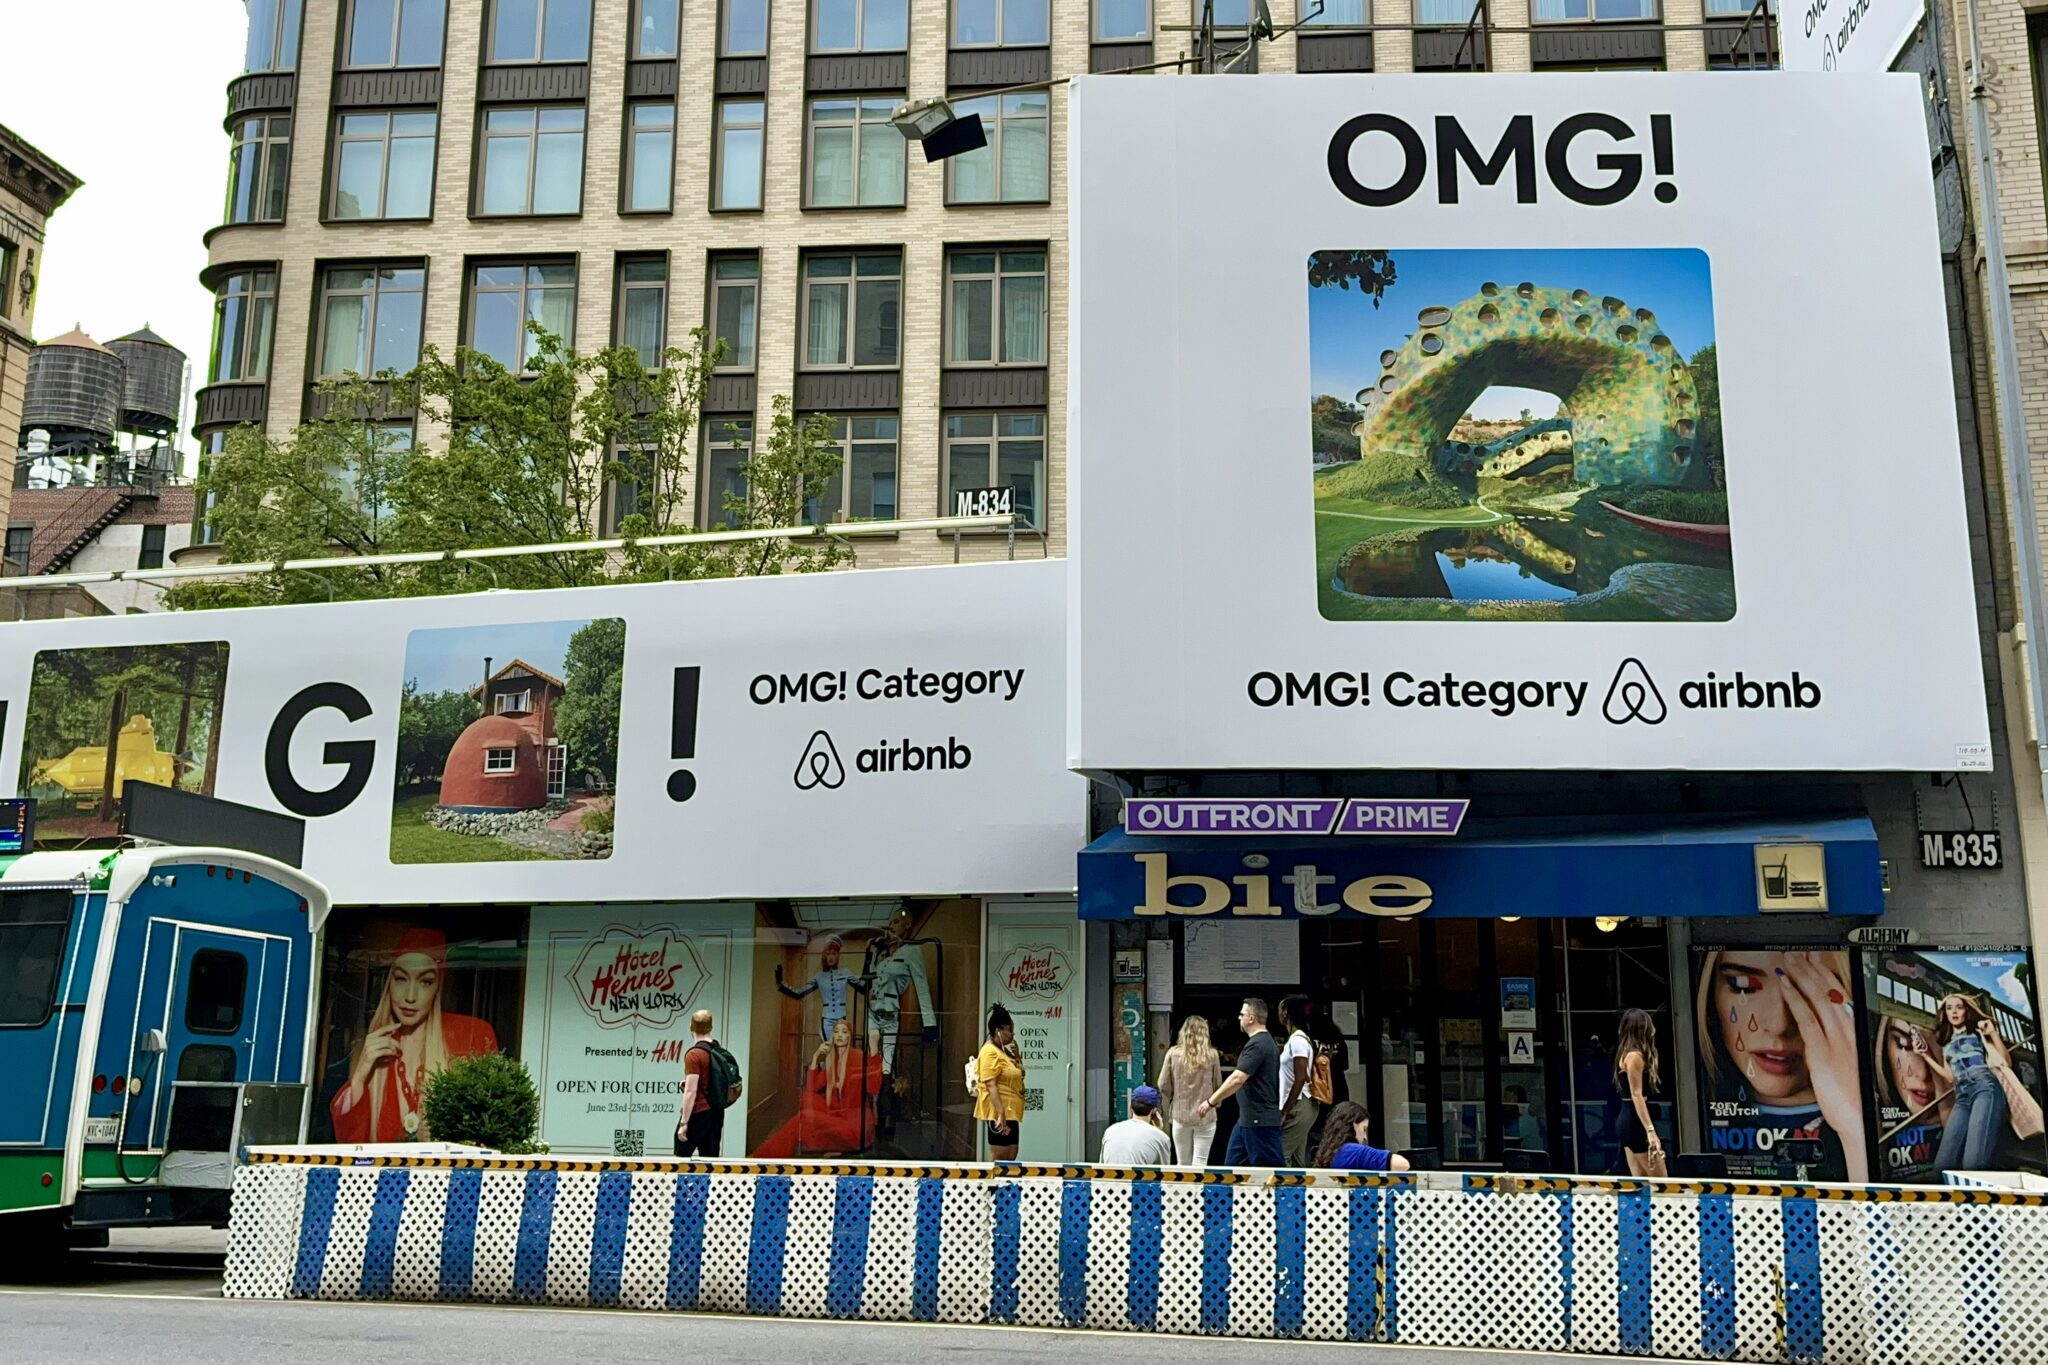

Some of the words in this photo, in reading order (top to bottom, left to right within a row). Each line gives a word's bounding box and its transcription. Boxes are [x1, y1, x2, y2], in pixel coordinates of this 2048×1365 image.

[1327, 112, 1678, 207] OMG!
[957, 488, 1011, 517] M-834
[749, 671, 847, 705] OMG!
[856, 667, 1025, 704] Category
[1247, 671, 1371, 708] OMG!
[1382, 671, 1589, 717] Category
[1679, 671, 1822, 709] airbnb
[264, 681, 376, 817] G
[855, 736, 972, 774] airbnb
[1137, 803, 1323, 829] OUTFRONT
[1355, 805, 1450, 829] PRIME
[1923, 833, 1998, 867] M-835
[1133, 852, 1434, 916] bite
[590, 964, 683, 1006] Hennes
[1008, 966, 1061, 988] Hennes
[1019, 981, 1038, 993] NEW
[609, 993, 640, 1013] NEW
[643, 992, 686, 1010] YORK
[1020, 1028, 1049, 1037] OPEN
[585, 1046, 633, 1057] Presented
[636, 1046, 649, 1060] by
[651, 1039, 684, 1063] H&M
[1024, 1040, 1044, 1049] FOR
[1512, 1036, 1530, 1055] A
[1020, 1051, 1059, 1060] ECK-IN
[556, 1080, 597, 1094] OPEN
[601, 1080, 631, 1094] FOR
[586, 1102, 606, 1114] June
[652, 1103, 675, 1113] 2022
[1710, 1101, 1739, 1111] ZOEY
[1715, 1107, 1760, 1117] DEUTCH
[1896, 1127, 1926, 1147] NOT
[1753, 1166, 1778, 1176] hulu
